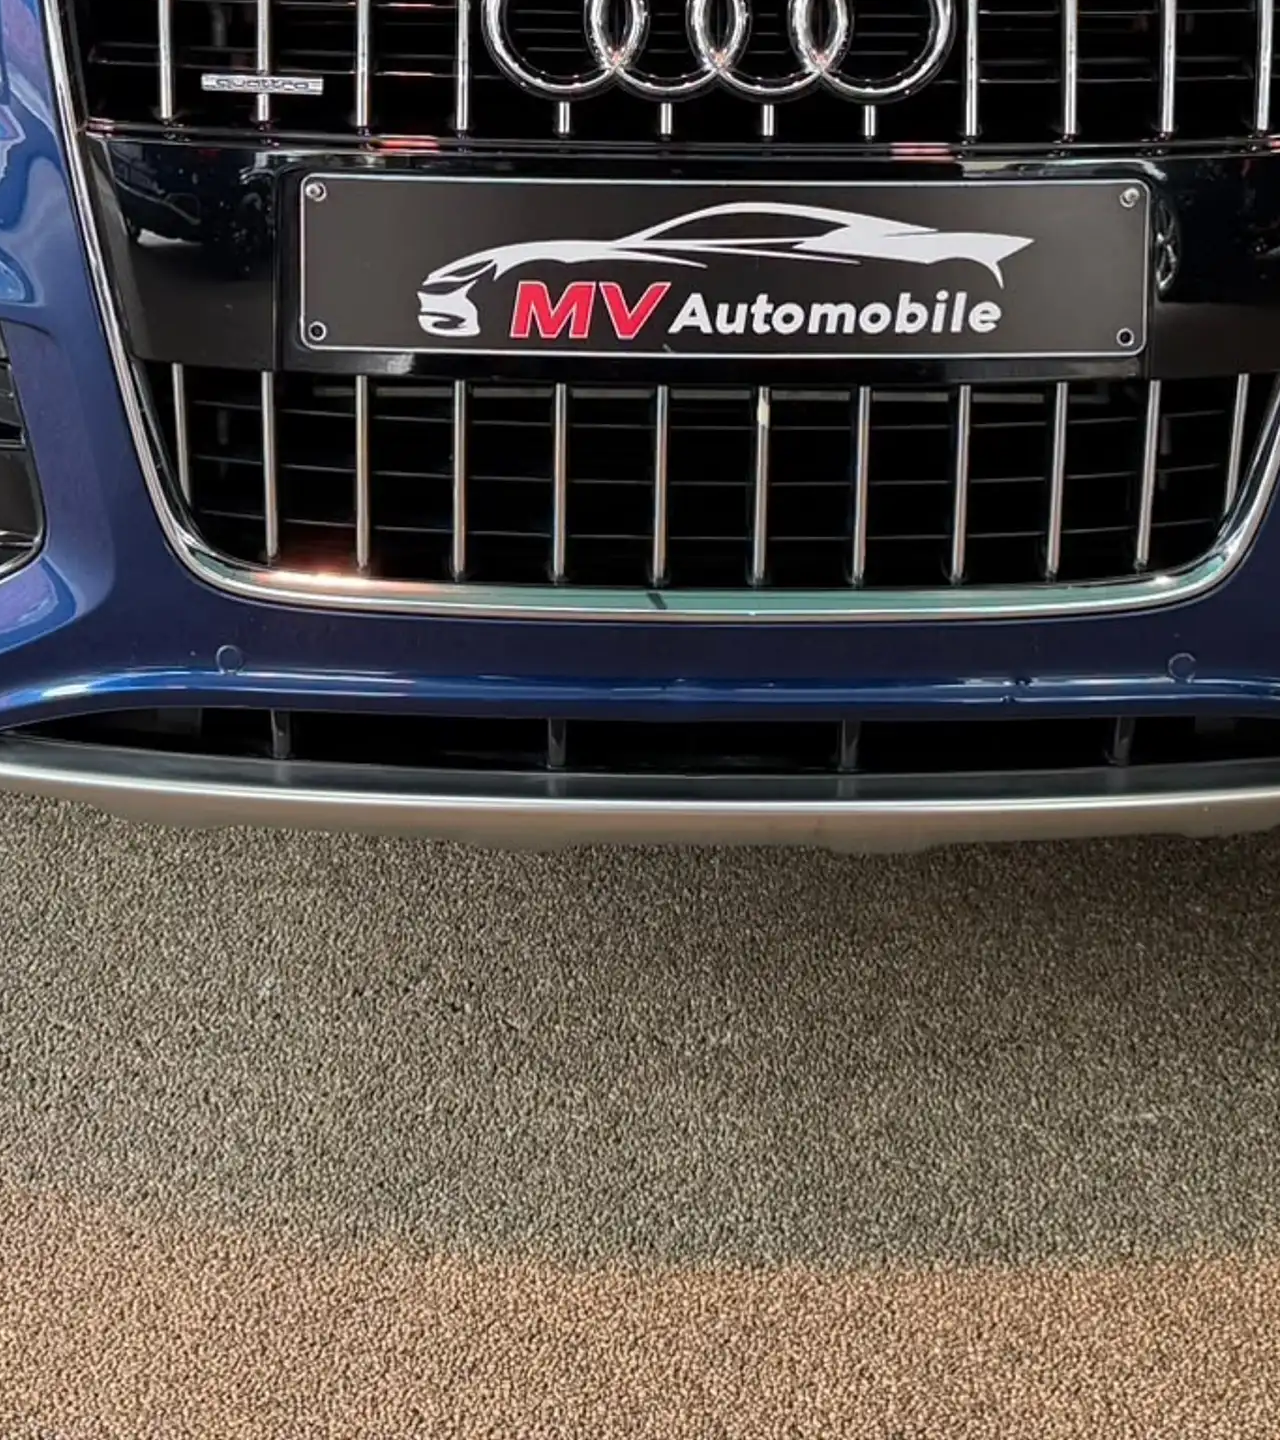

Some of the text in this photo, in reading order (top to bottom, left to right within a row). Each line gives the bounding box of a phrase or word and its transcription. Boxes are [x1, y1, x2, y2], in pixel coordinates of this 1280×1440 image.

[214, 76, 312, 92] quattro
[509, 281, 1002, 339] MV Automobile
